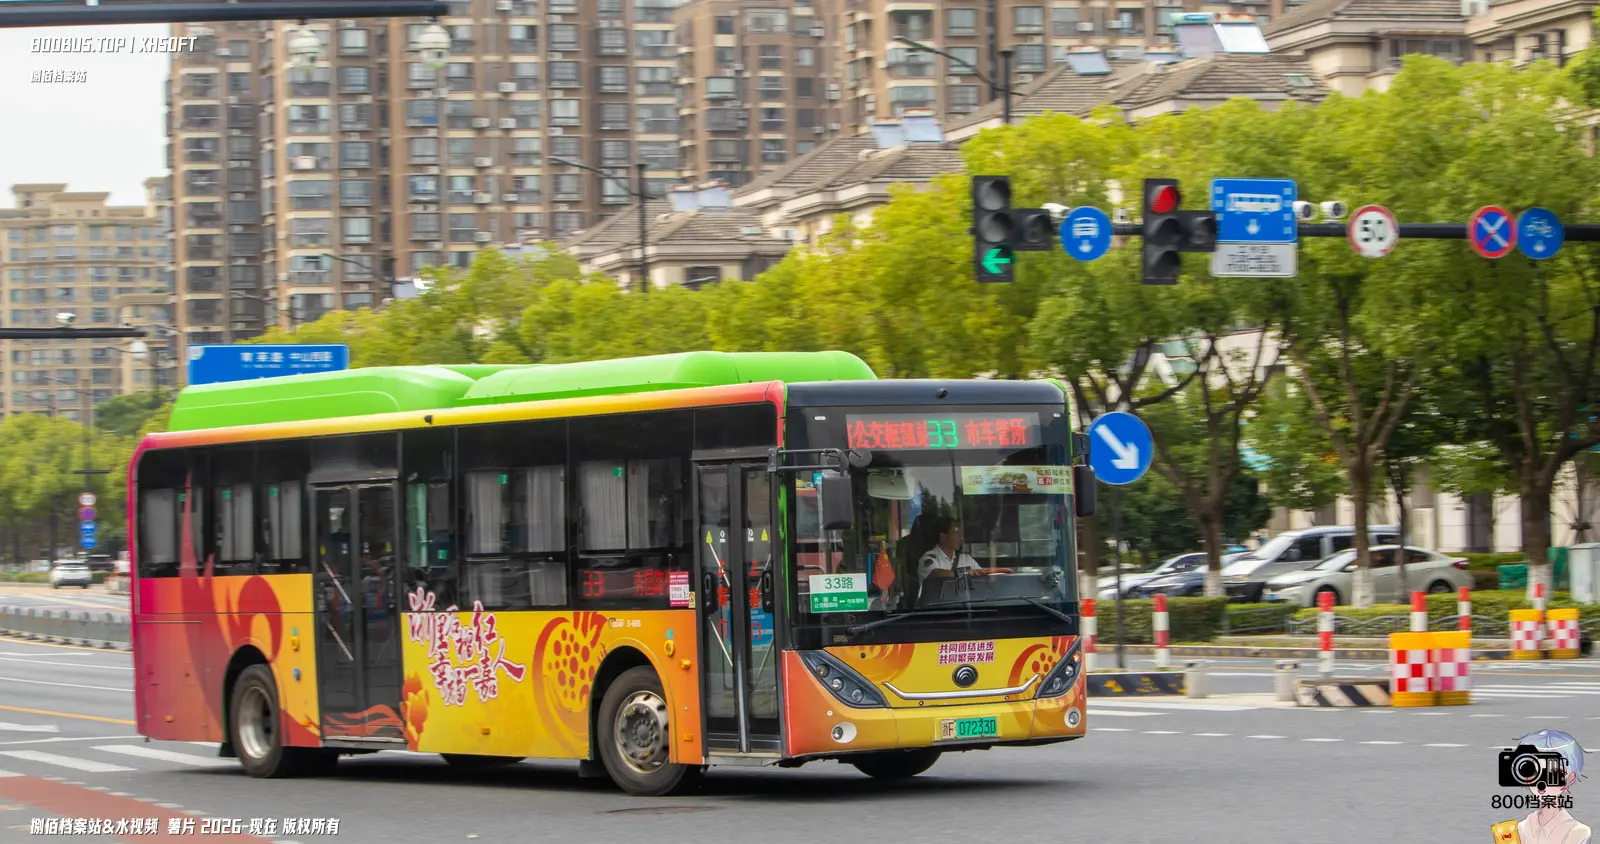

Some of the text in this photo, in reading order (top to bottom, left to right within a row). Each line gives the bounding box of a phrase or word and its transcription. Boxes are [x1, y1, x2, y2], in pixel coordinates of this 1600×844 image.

[1362, 219, 1387, 242] 50
[927, 420, 959, 447] 33
[965, 418, 1026, 447] 市车管所
[583, 570, 605, 597] 33
[824, 577, 854, 589] 33路
[939, 641, 995, 653] 共同团结进步
[939, 651, 995, 664] 共同繁荣发展
